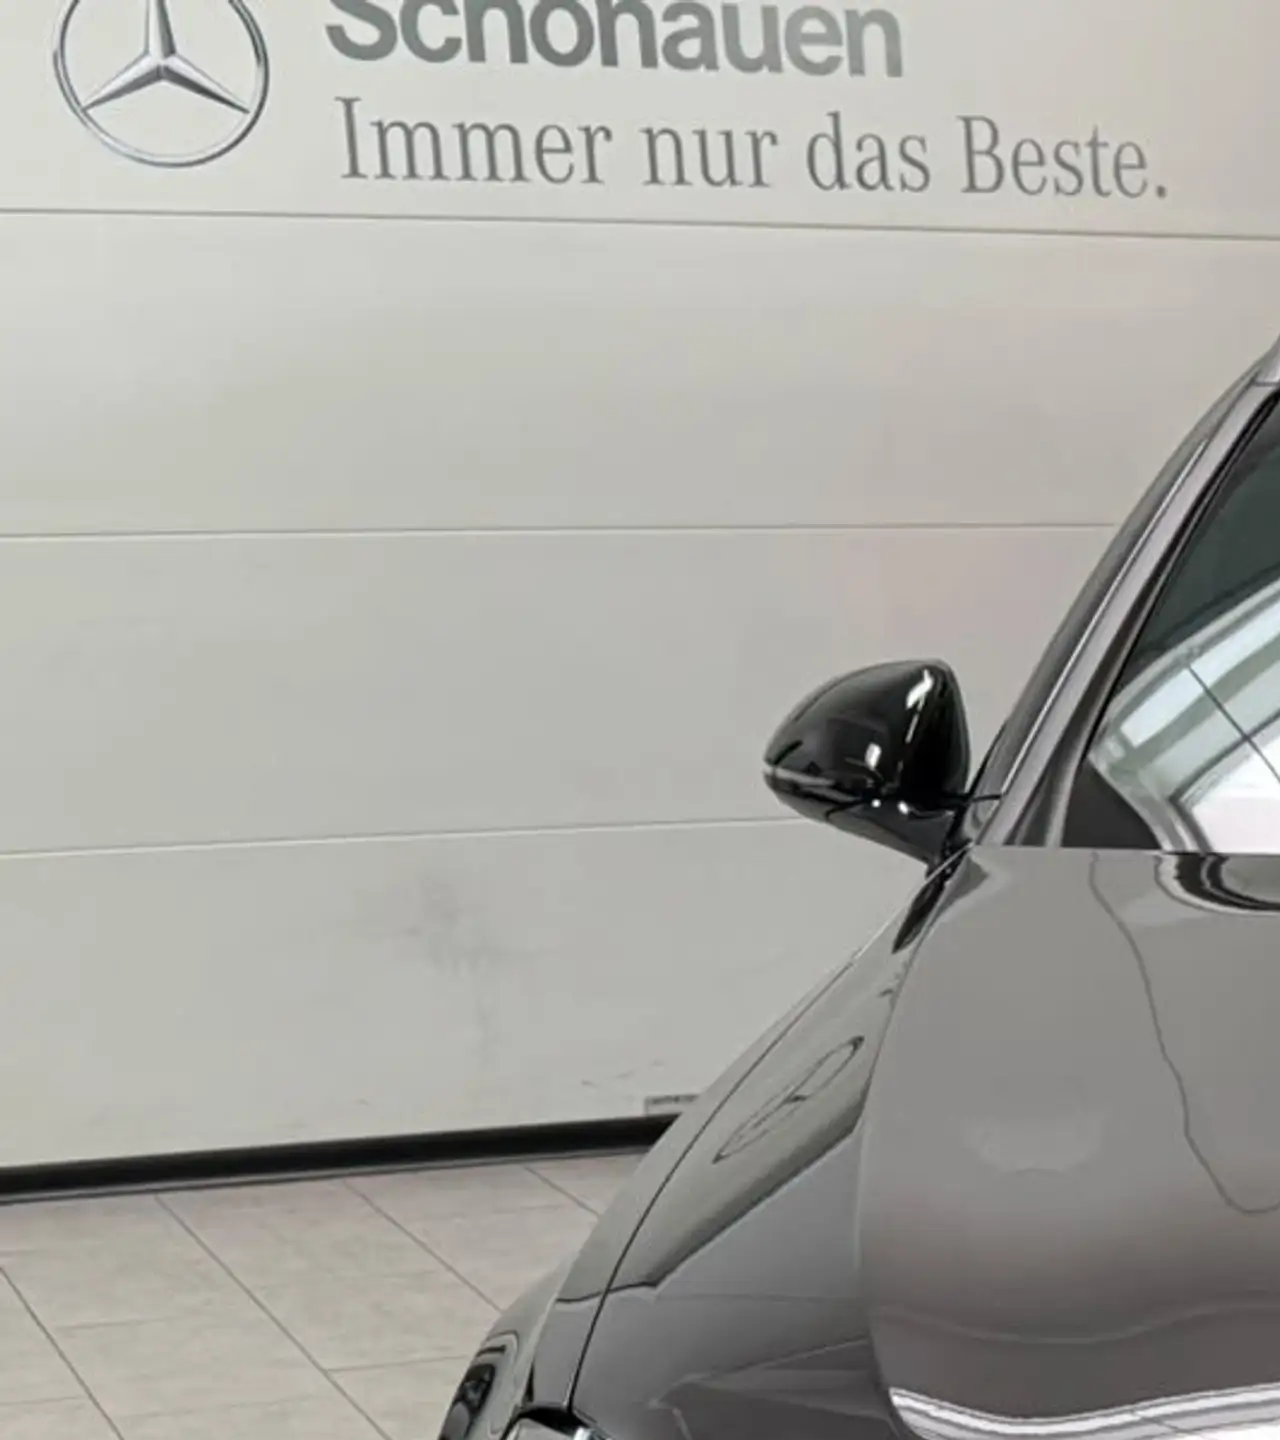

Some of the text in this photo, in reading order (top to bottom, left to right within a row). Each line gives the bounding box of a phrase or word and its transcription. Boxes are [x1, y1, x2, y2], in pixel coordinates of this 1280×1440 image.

[335, 96, 1168, 199] Immer nur das Beste.
